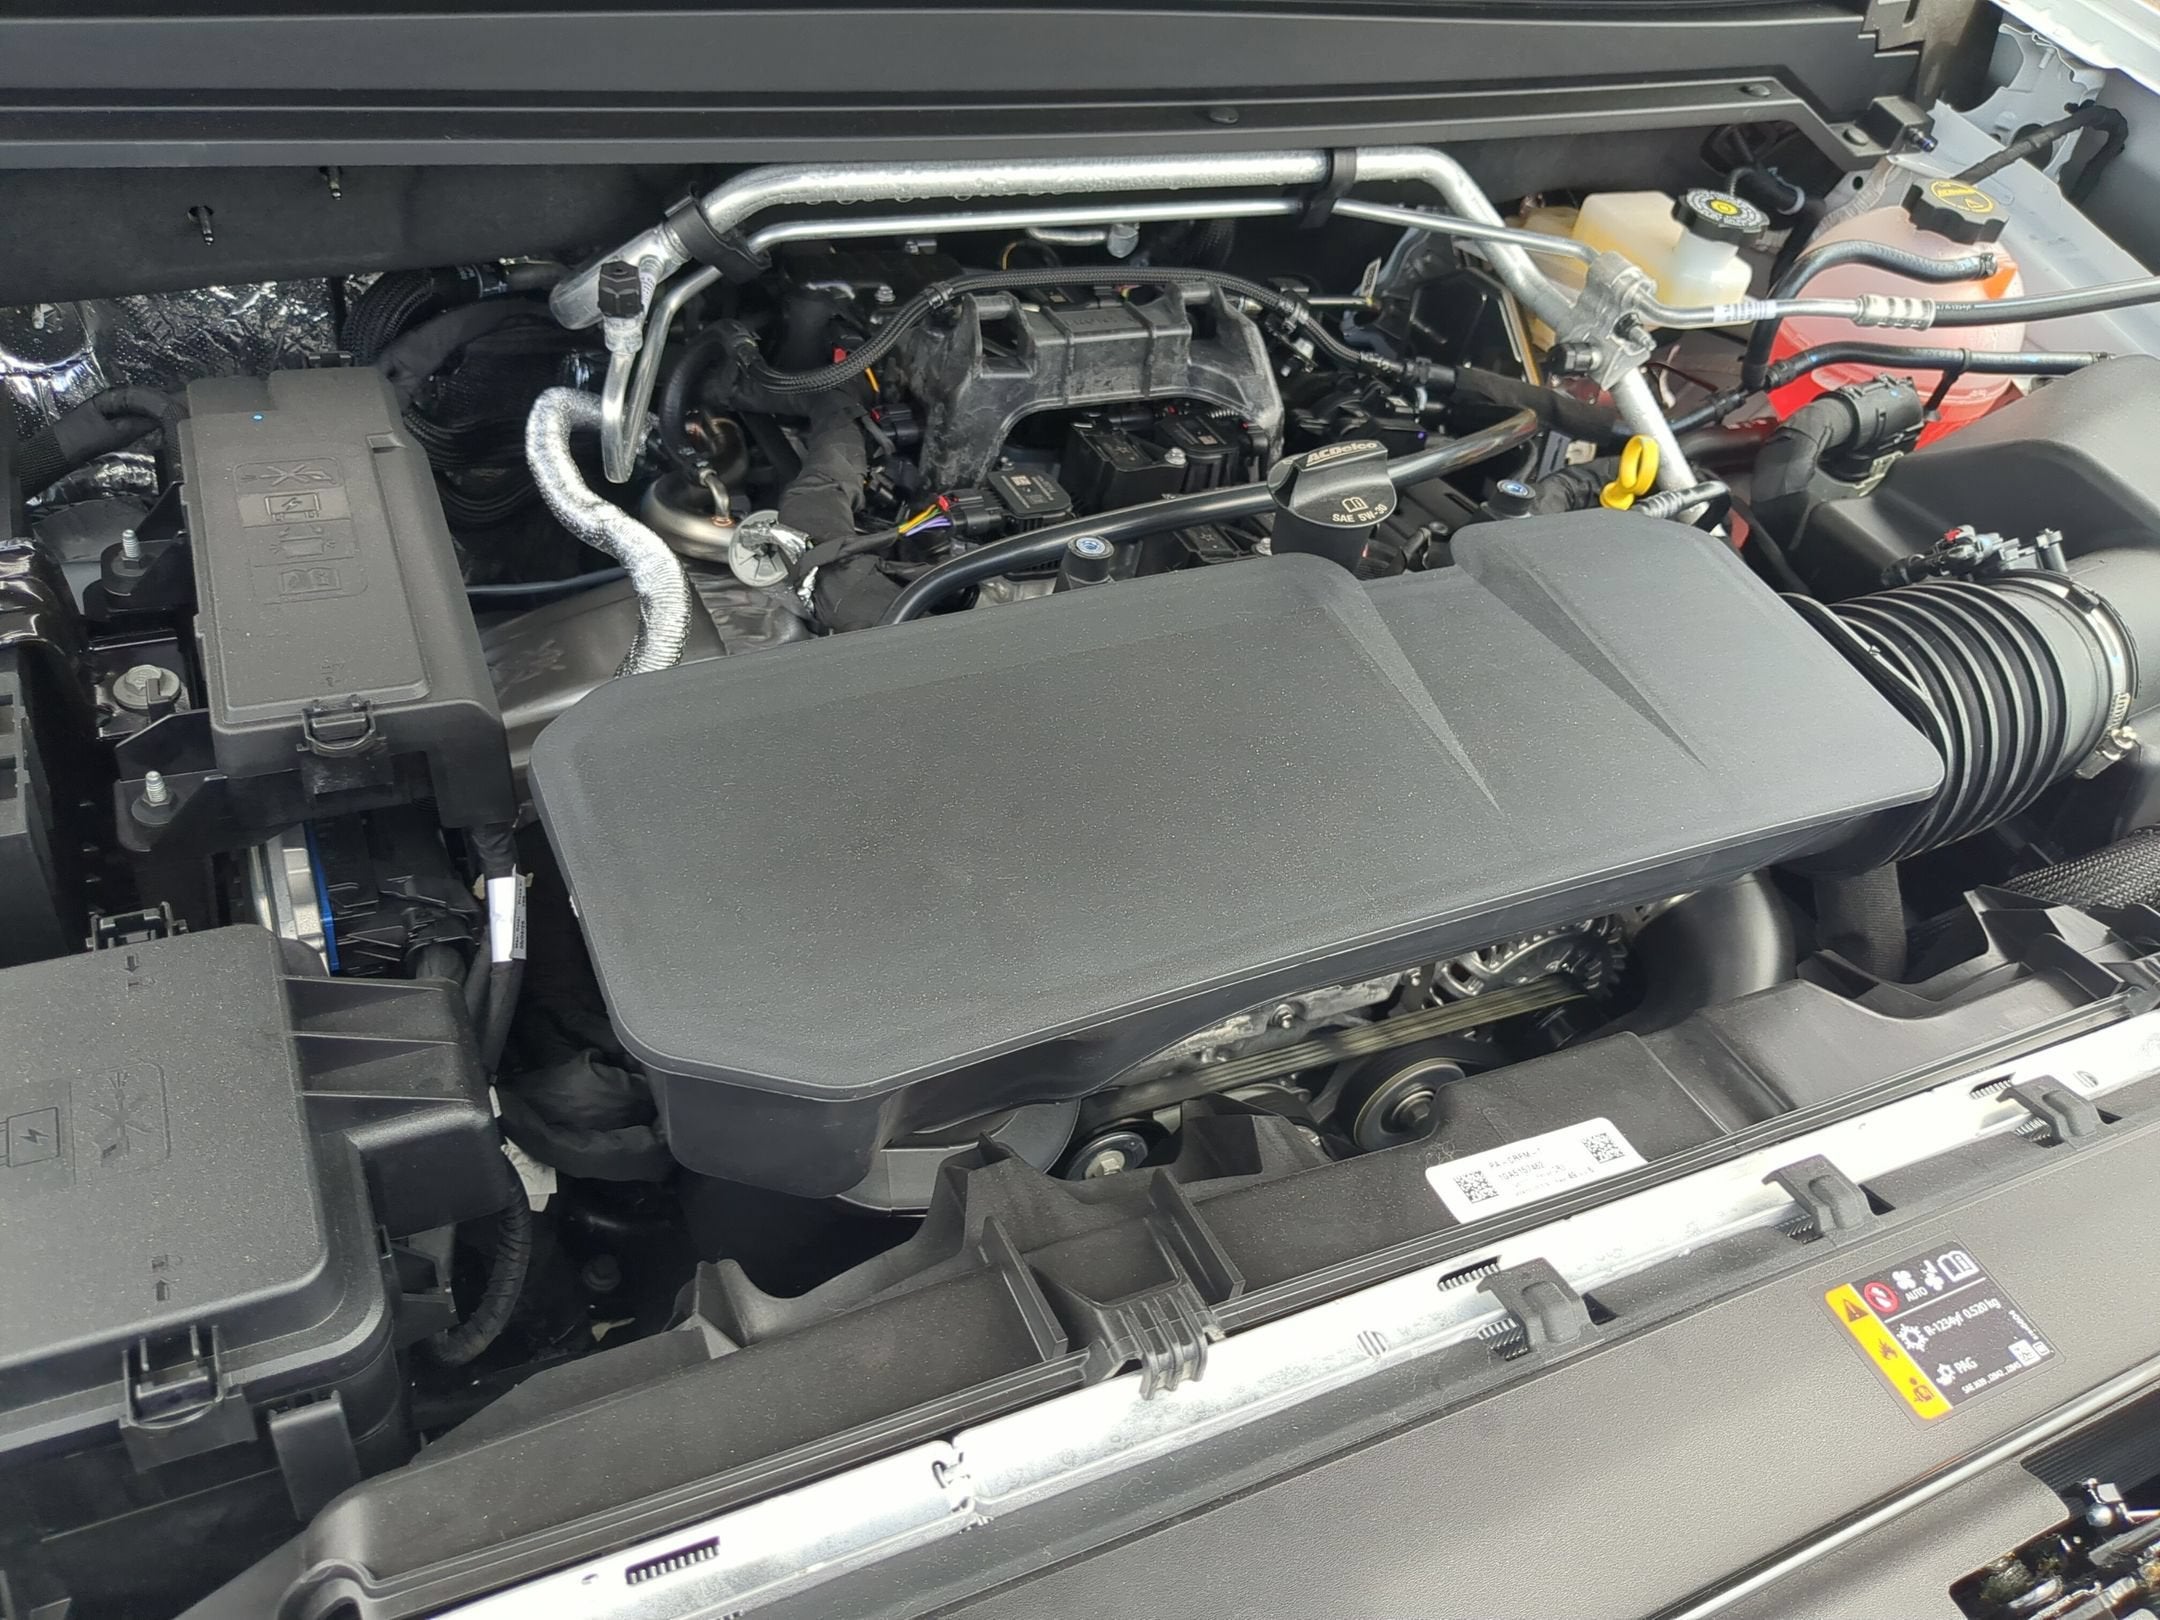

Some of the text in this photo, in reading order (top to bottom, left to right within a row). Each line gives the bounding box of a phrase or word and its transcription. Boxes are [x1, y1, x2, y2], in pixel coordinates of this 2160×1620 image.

[1306, 442, 1378, 464] ACDelco
[1332, 503, 1388, 523] SAE 5W-30
[1905, 1286, 1929, 1302] AUTO
[1923, 1311, 1964, 1336] R-1234yf
[1983, 1298, 2002, 1310] kg
[1953, 1356, 1978, 1374] PAG
